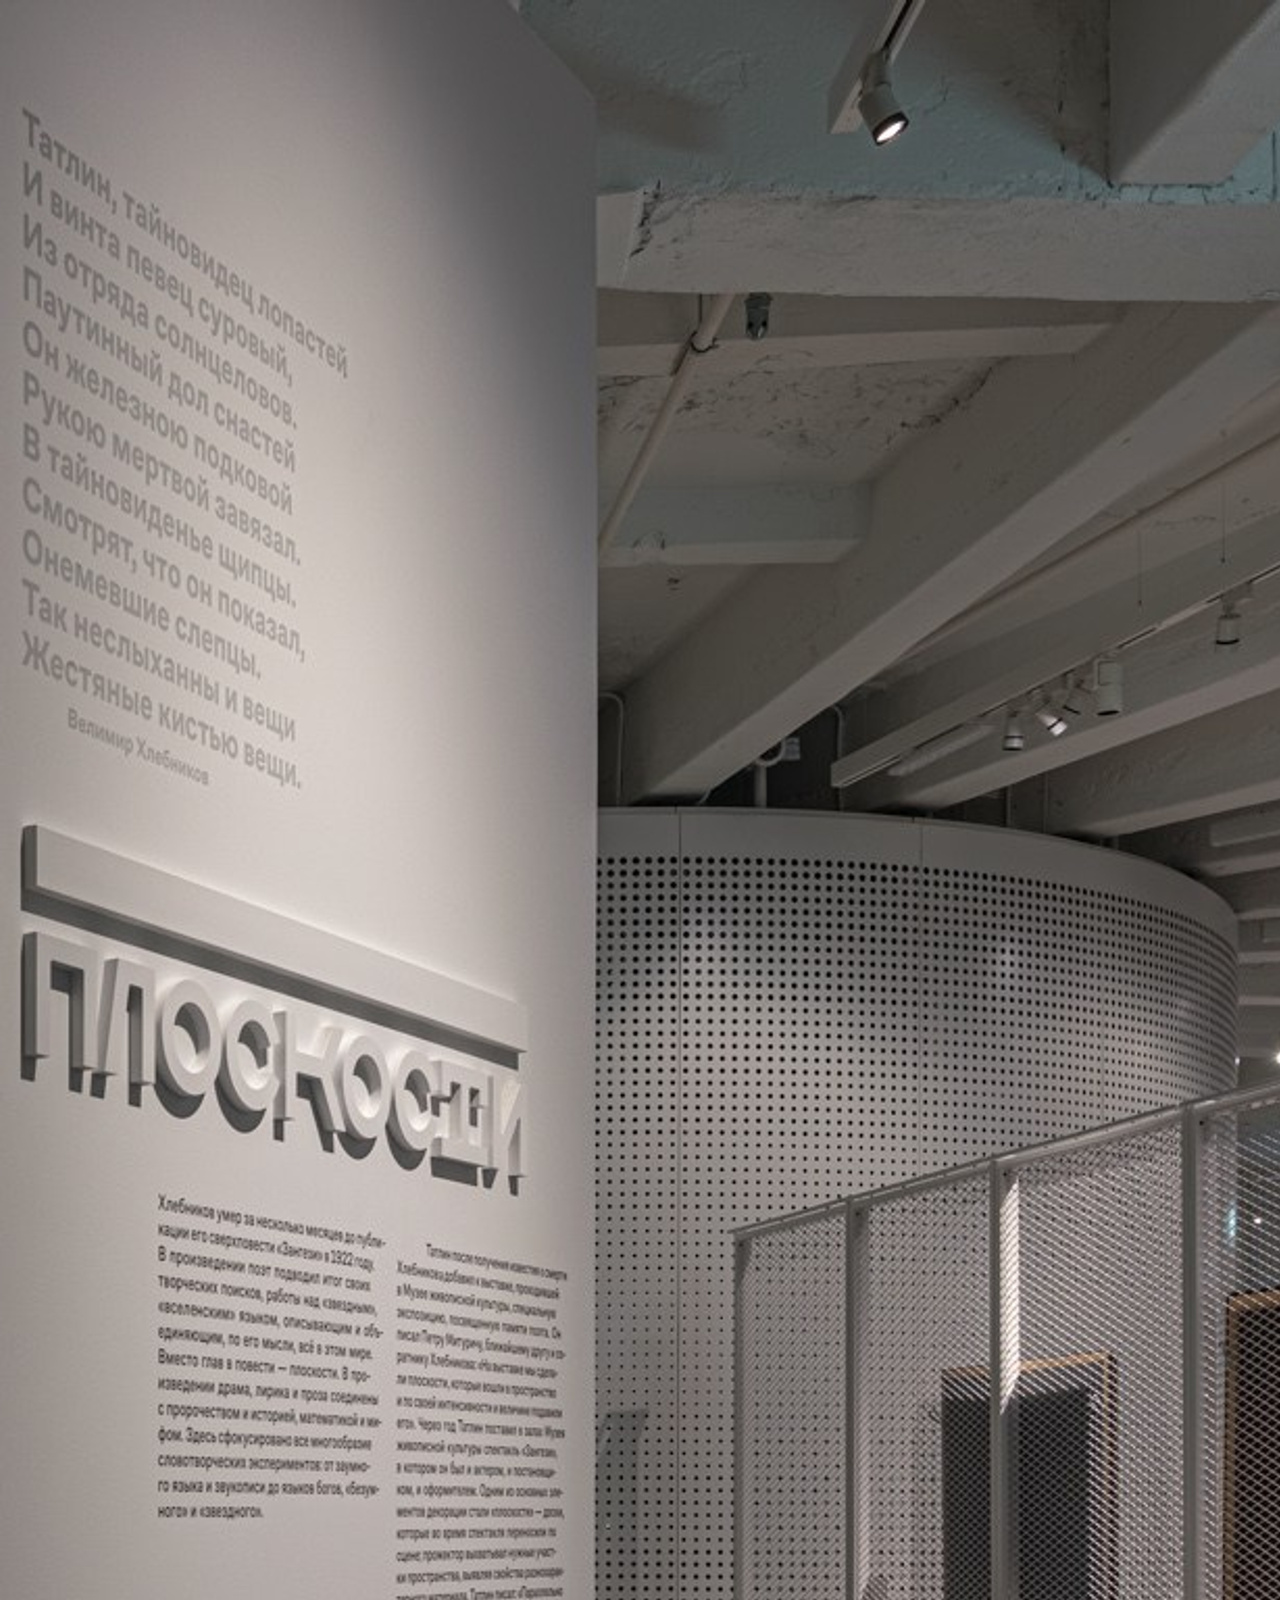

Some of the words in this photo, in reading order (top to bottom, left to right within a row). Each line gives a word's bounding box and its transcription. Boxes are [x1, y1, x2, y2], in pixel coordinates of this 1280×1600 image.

[22, 108, 116, 215] Татлин,
[123, 192, 254, 315] тайновидец
[22, 160, 43, 206] И
[49, 189, 120, 261] винта
[126, 244, 193, 318] певец
[197, 295, 292, 388] суровый,
[22, 213, 57, 268] Из
[63, 250, 149, 330] отряда
[154, 313, 296, 430] солнцеловов.
[22, 265, 162, 388] Паутинный
[167, 370, 208, 418] дол
[213, 400, 295, 474] снастей
[22, 317, 59, 372] Он
[65, 353, 188, 452] железною
[193, 434, 292, 516] подковой
[22, 369, 106, 451] Рукою
[111, 432, 209, 512] мертвой
[214, 495, 300, 566] завязал.
[22, 422, 40, 464] В
[47, 445, 213, 561] тайновиденье
[218, 544, 295, 608] щипцы.
[22, 474, 137, 574] Смотрят,
[142, 549, 181, 591] что
[186, 573, 212, 608] он
[217, 590, 304, 663] показал,
[22, 526, 169, 633] Онемевшие
[174, 614, 260, 679] слепцы.
[22, 578, 67, 631] Так
[73, 613, 219, 705] неслыханны
[224, 687, 238, 714] и
[242, 696, 295, 742] вещи
[22, 630, 152, 721] Жестяные
[158, 703, 238, 761] кистью
[243, 742, 300, 789] вещи.
[68, 708, 134, 756] Велимир
[136, 737, 209, 786] Хлебников
[158, 1222, 189, 1241] кации
[190, 1228, 208, 1242] его
[208, 1231, 275, 1253] сверхповести
[323, 1250, 329, 1262] в
[330, 1247, 353, 1266] 1922
[159, 1192, 215, 1219] Хлебников
[216, 1207, 242, 1228] умер
[243, 1212, 254, 1226] за
[255, 1214, 304, 1235] несколько
[305, 1224, 344, 1243] месяцев
[344, 1231, 355, 1245] до
[158, 1243, 166, 1261] В
[168, 1250, 246, 1273] произведении
[247, 1262, 271, 1277] поэт
[273, 1266, 320, 1285] подводил
[322, 1273, 342, 1287] итог
[344, 1277, 371, 1291] своих
[159, 1274, 218, 1294] творческих
[220, 1282, 263, 1303] поисков,
[265, 1286, 301, 1305] работы
[302, 1294, 320, 1310] над
[158, 1299, 235, 1320] «вселенским»
[238, 1309, 280, 1329] языком,
[282, 1315, 352, 1336] описывающим
[354, 1324, 361, 1335] и
[158, 1325, 225, 1348] единяющим,
[227, 1333, 240, 1346] по
[242, 1334, 259, 1348] его
[261, 1336, 295, 1355] мысли,
[297, 1337, 314, 1353] всё
[316, 1342, 322, 1354] в
[324, 1343, 346, 1357] этом
[348, 1346, 372, 1363] мире.
[158, 1346, 198, 1366] Вместо
[201, 1355, 223, 1369] глав
[226, 1357, 232, 1369] в
[234, 1358, 275, 1373] повести
[288, 1363, 338, 1379] плоскости.
[341, 1364, 348, 1380] В
[350, 1369, 370, 1385] про-
[158, 1376, 215, 1394] изведении
[217, 1381, 252, 1399] драма,
[255, 1384, 289, 1401] лирика
[291, 1387, 298, 1399] и
[300, 1388, 328, 1404] проза
[329, 1390, 379, 1405] соединены
[158, 1402, 164, 1415] с
[166, 1403, 240, 1421] пророчеством
[241, 1408, 248, 1420] и
[250, 1406, 297, 1426] историей,
[298, 1411, 358, 1426] математикой
[359, 1415, 365, 1426] и
[365, 1416, 380, 1427] ми-
[158, 1423, 182, 1445] фом.
[185, 1425, 216, 1444] Здесь
[217, 1427, 292, 1449] сфокусировано
[309, 1433, 372, 1453] многообразие
[158, 1454, 246, 1472] словотворческих
[322, 1459, 333, 1471] от
[334, 1460, 369, 1475] заумно-
[158, 1479, 169, 1492] го
[171, 1479, 203, 1492] языка
[205, 1480, 212, 1492] и
[214, 1480, 266, 1497] звукописи
[266, 1482, 279, 1496] до
[281, 1482, 314, 1494] языков
[315, 1478, 343, 1497] богов,
[158, 1505, 188, 1517] ного»
[189, 1505, 197, 1517] и
